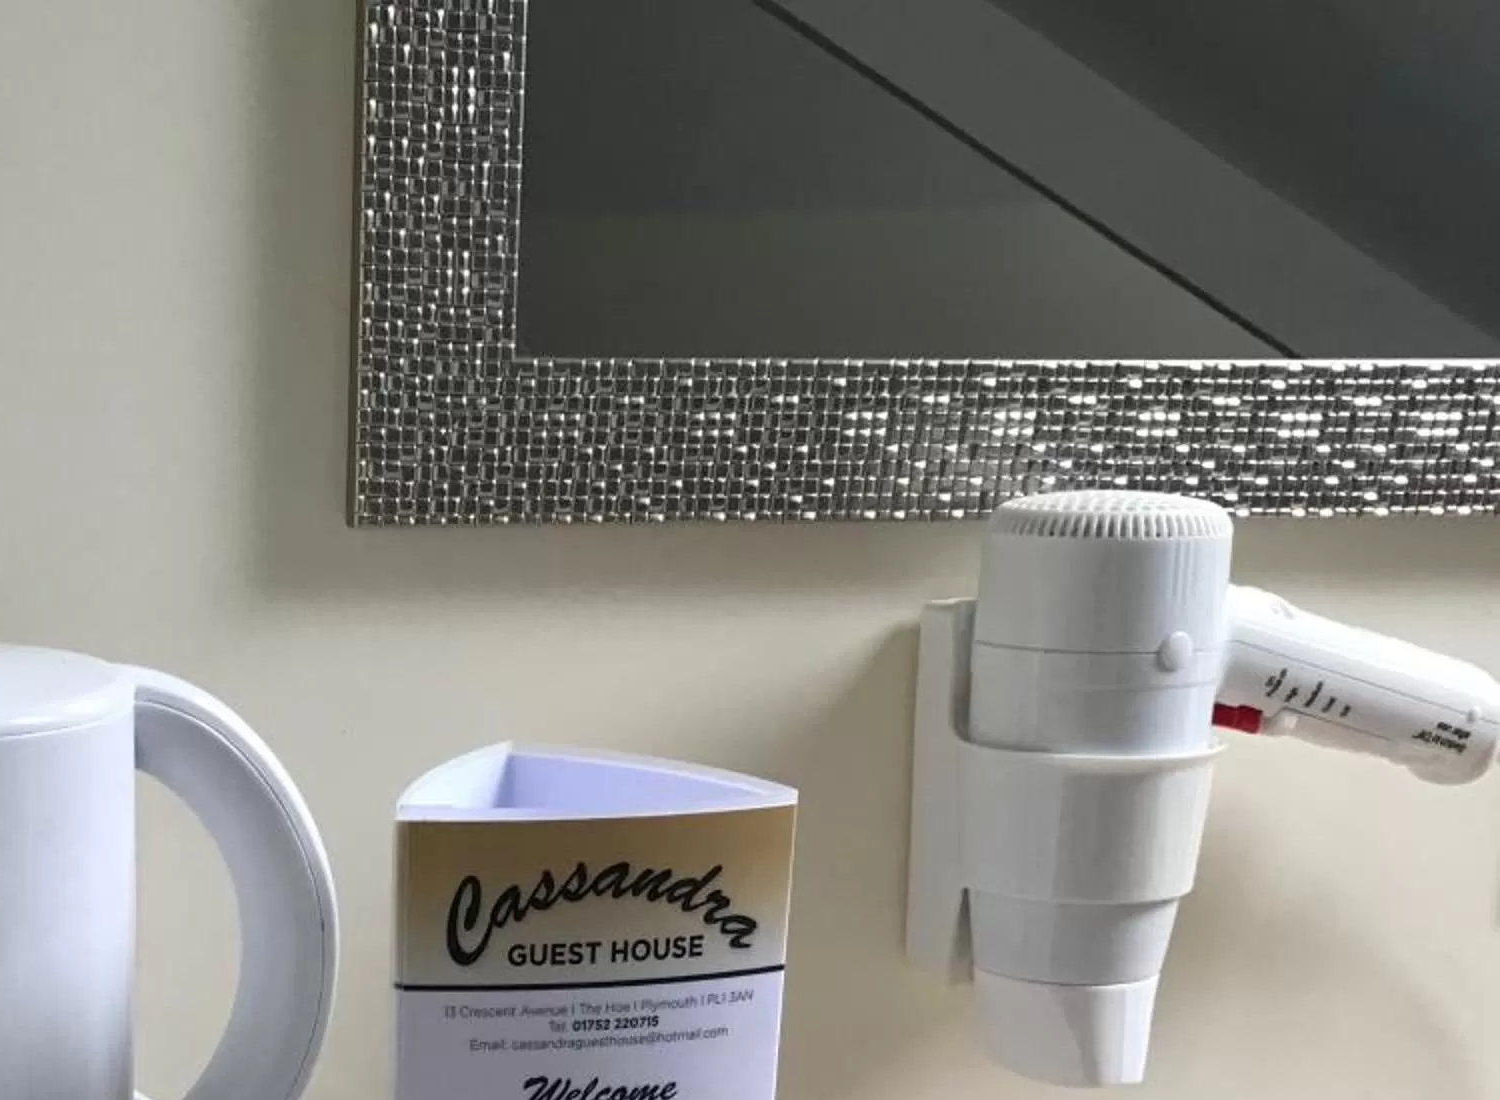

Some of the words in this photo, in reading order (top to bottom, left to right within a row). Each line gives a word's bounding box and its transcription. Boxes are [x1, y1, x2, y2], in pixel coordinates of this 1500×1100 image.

[446, 860, 757, 967] Cassandra
[507, 942, 601, 967] GUEST
[610, 934, 705, 963] HOUSE
[460, 1005, 516, 1018] Crescent
[521, 1003, 568, 1017] Avenue
[580, 1002, 601, 1015] The
[640, 996, 698, 1015] Plymouth
[572, 1019, 611, 1032] 01752
[614, 1015, 659, 1031] 220715
